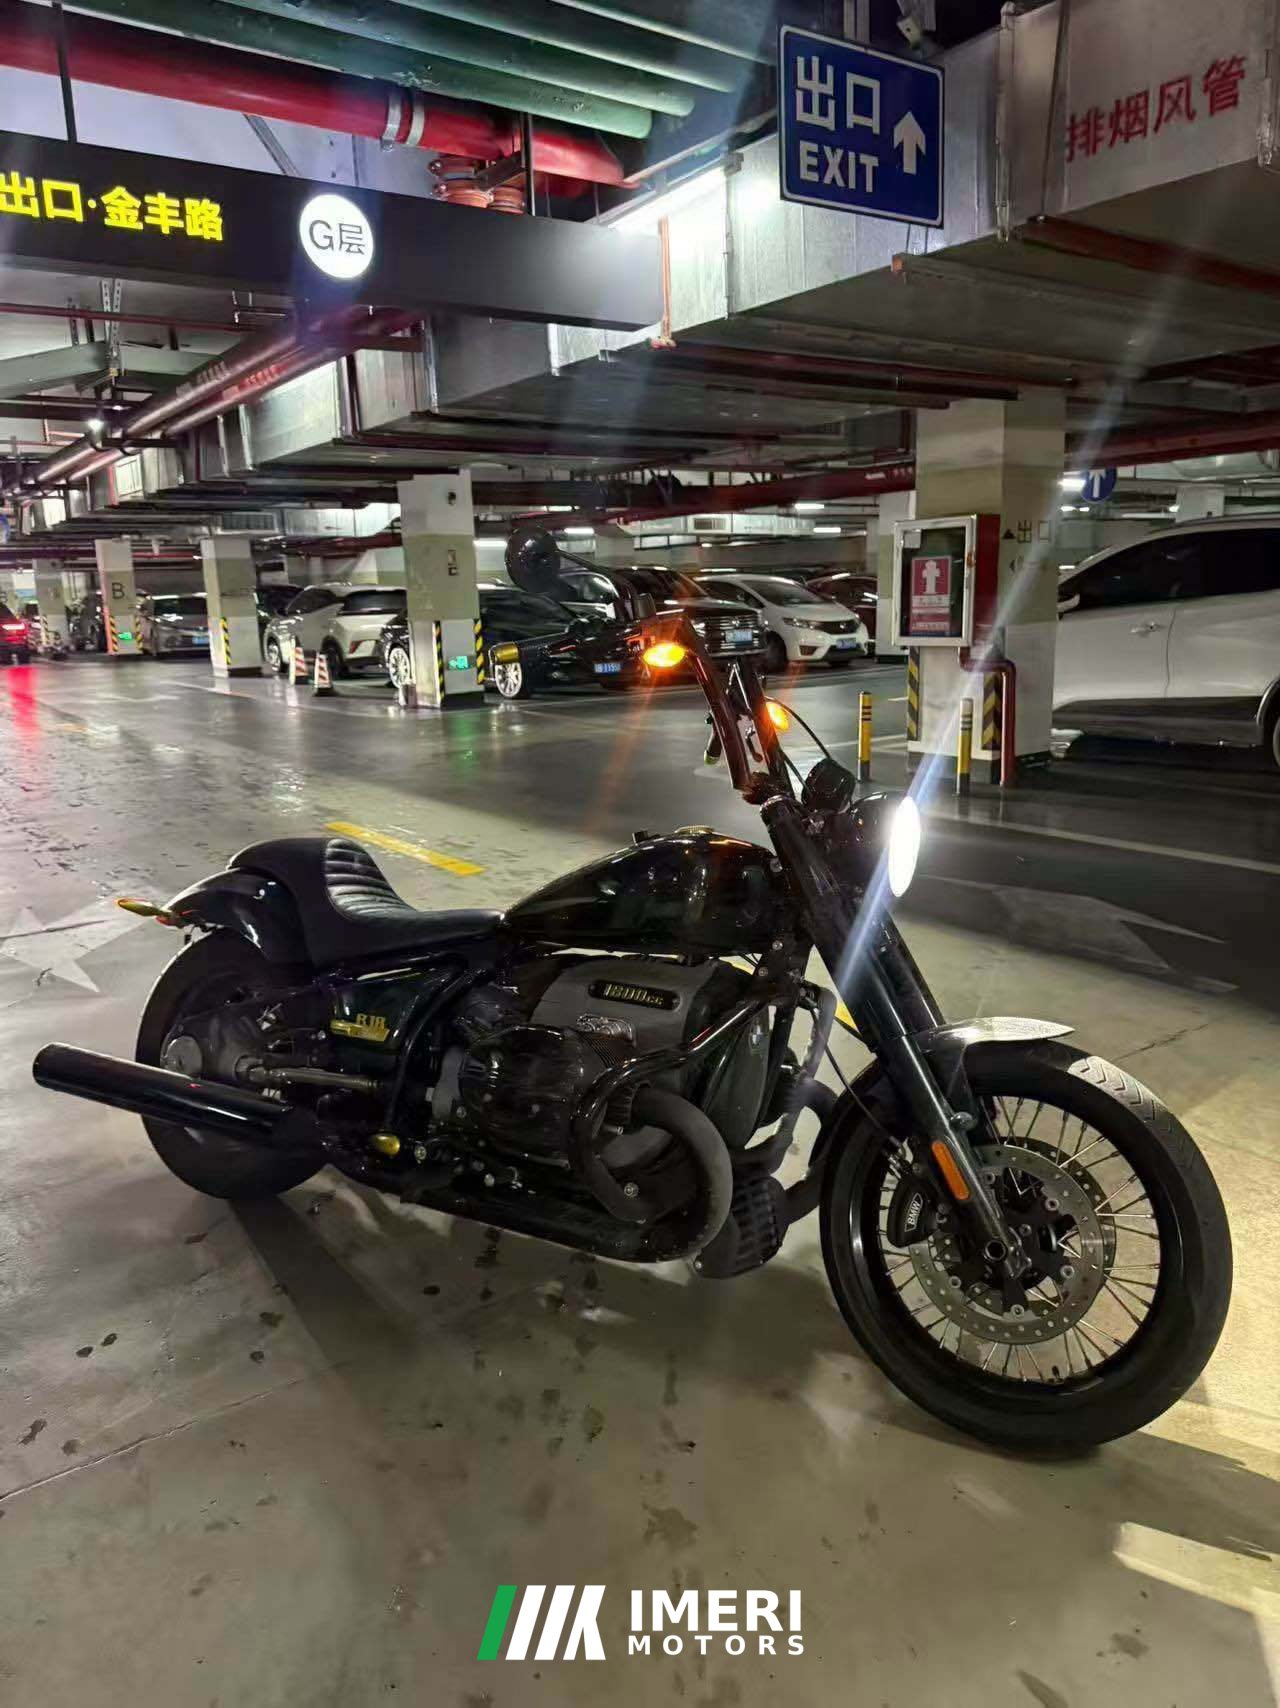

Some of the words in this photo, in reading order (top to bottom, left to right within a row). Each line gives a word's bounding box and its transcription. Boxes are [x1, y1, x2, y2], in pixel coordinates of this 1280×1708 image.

[794, 55, 881, 135] 出口
[1065, 55, 1247, 163] 排烟风管
[799, 143, 879, 193] EXIT
[308, 219, 368, 256] G层
[356, 1013, 387, 1032] R18
[907, 1200, 922, 1225] BMW
